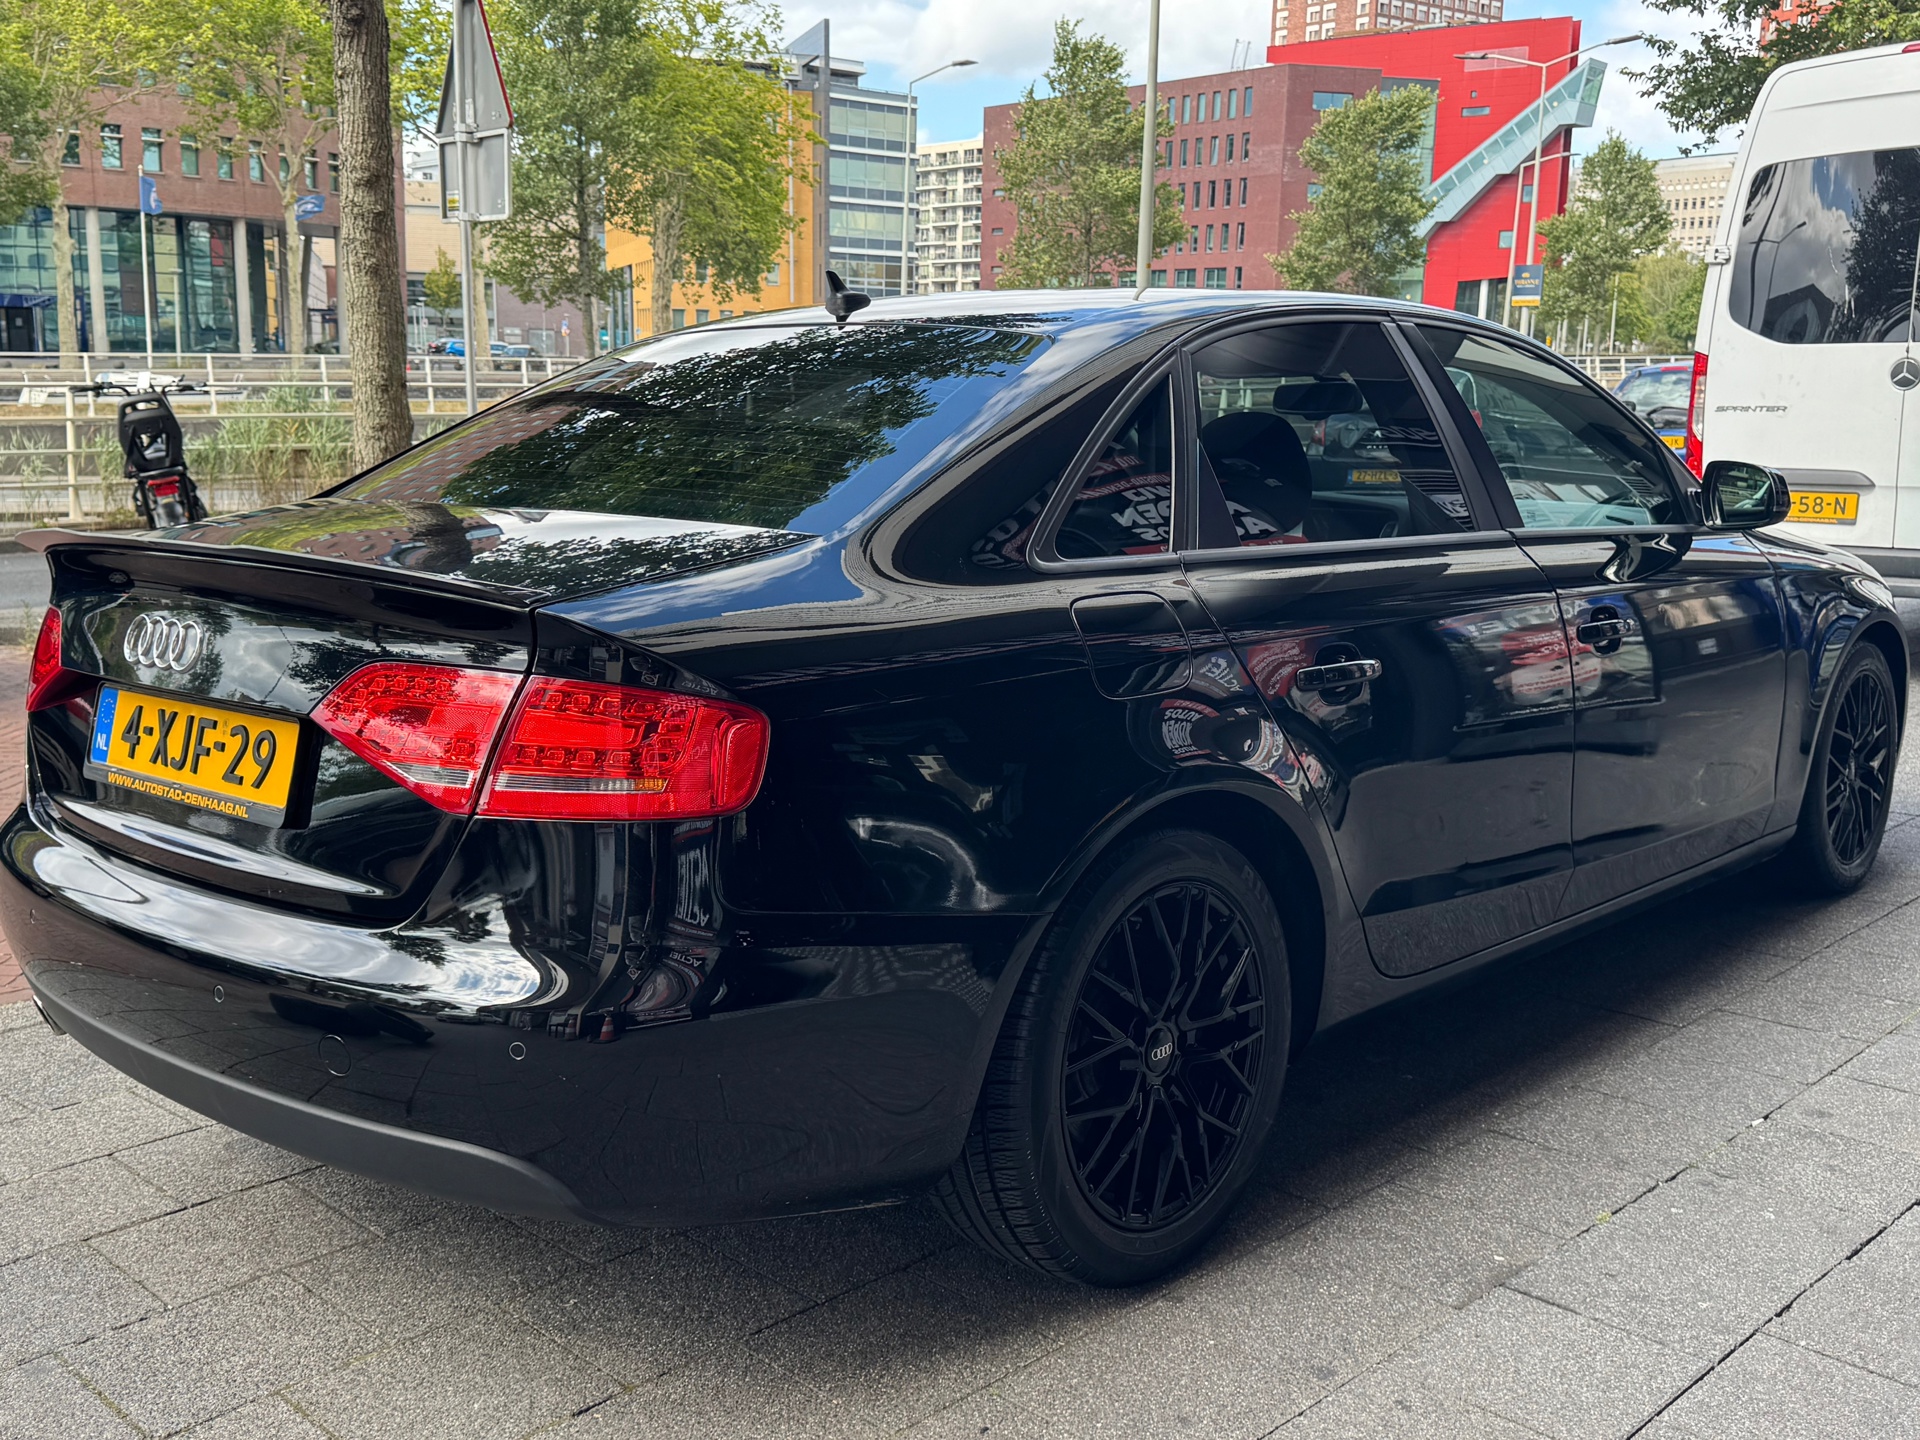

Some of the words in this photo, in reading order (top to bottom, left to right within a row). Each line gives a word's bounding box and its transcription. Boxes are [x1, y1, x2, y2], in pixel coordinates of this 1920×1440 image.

[1714, 405, 1788, 413] SPRINTER
[96, 732, 108, 751] NL
[121, 705, 277, 789] 4-XJF-29
[107, 772, 249, 819] WWW.AUTOSTAD-DENHAAG.NL
